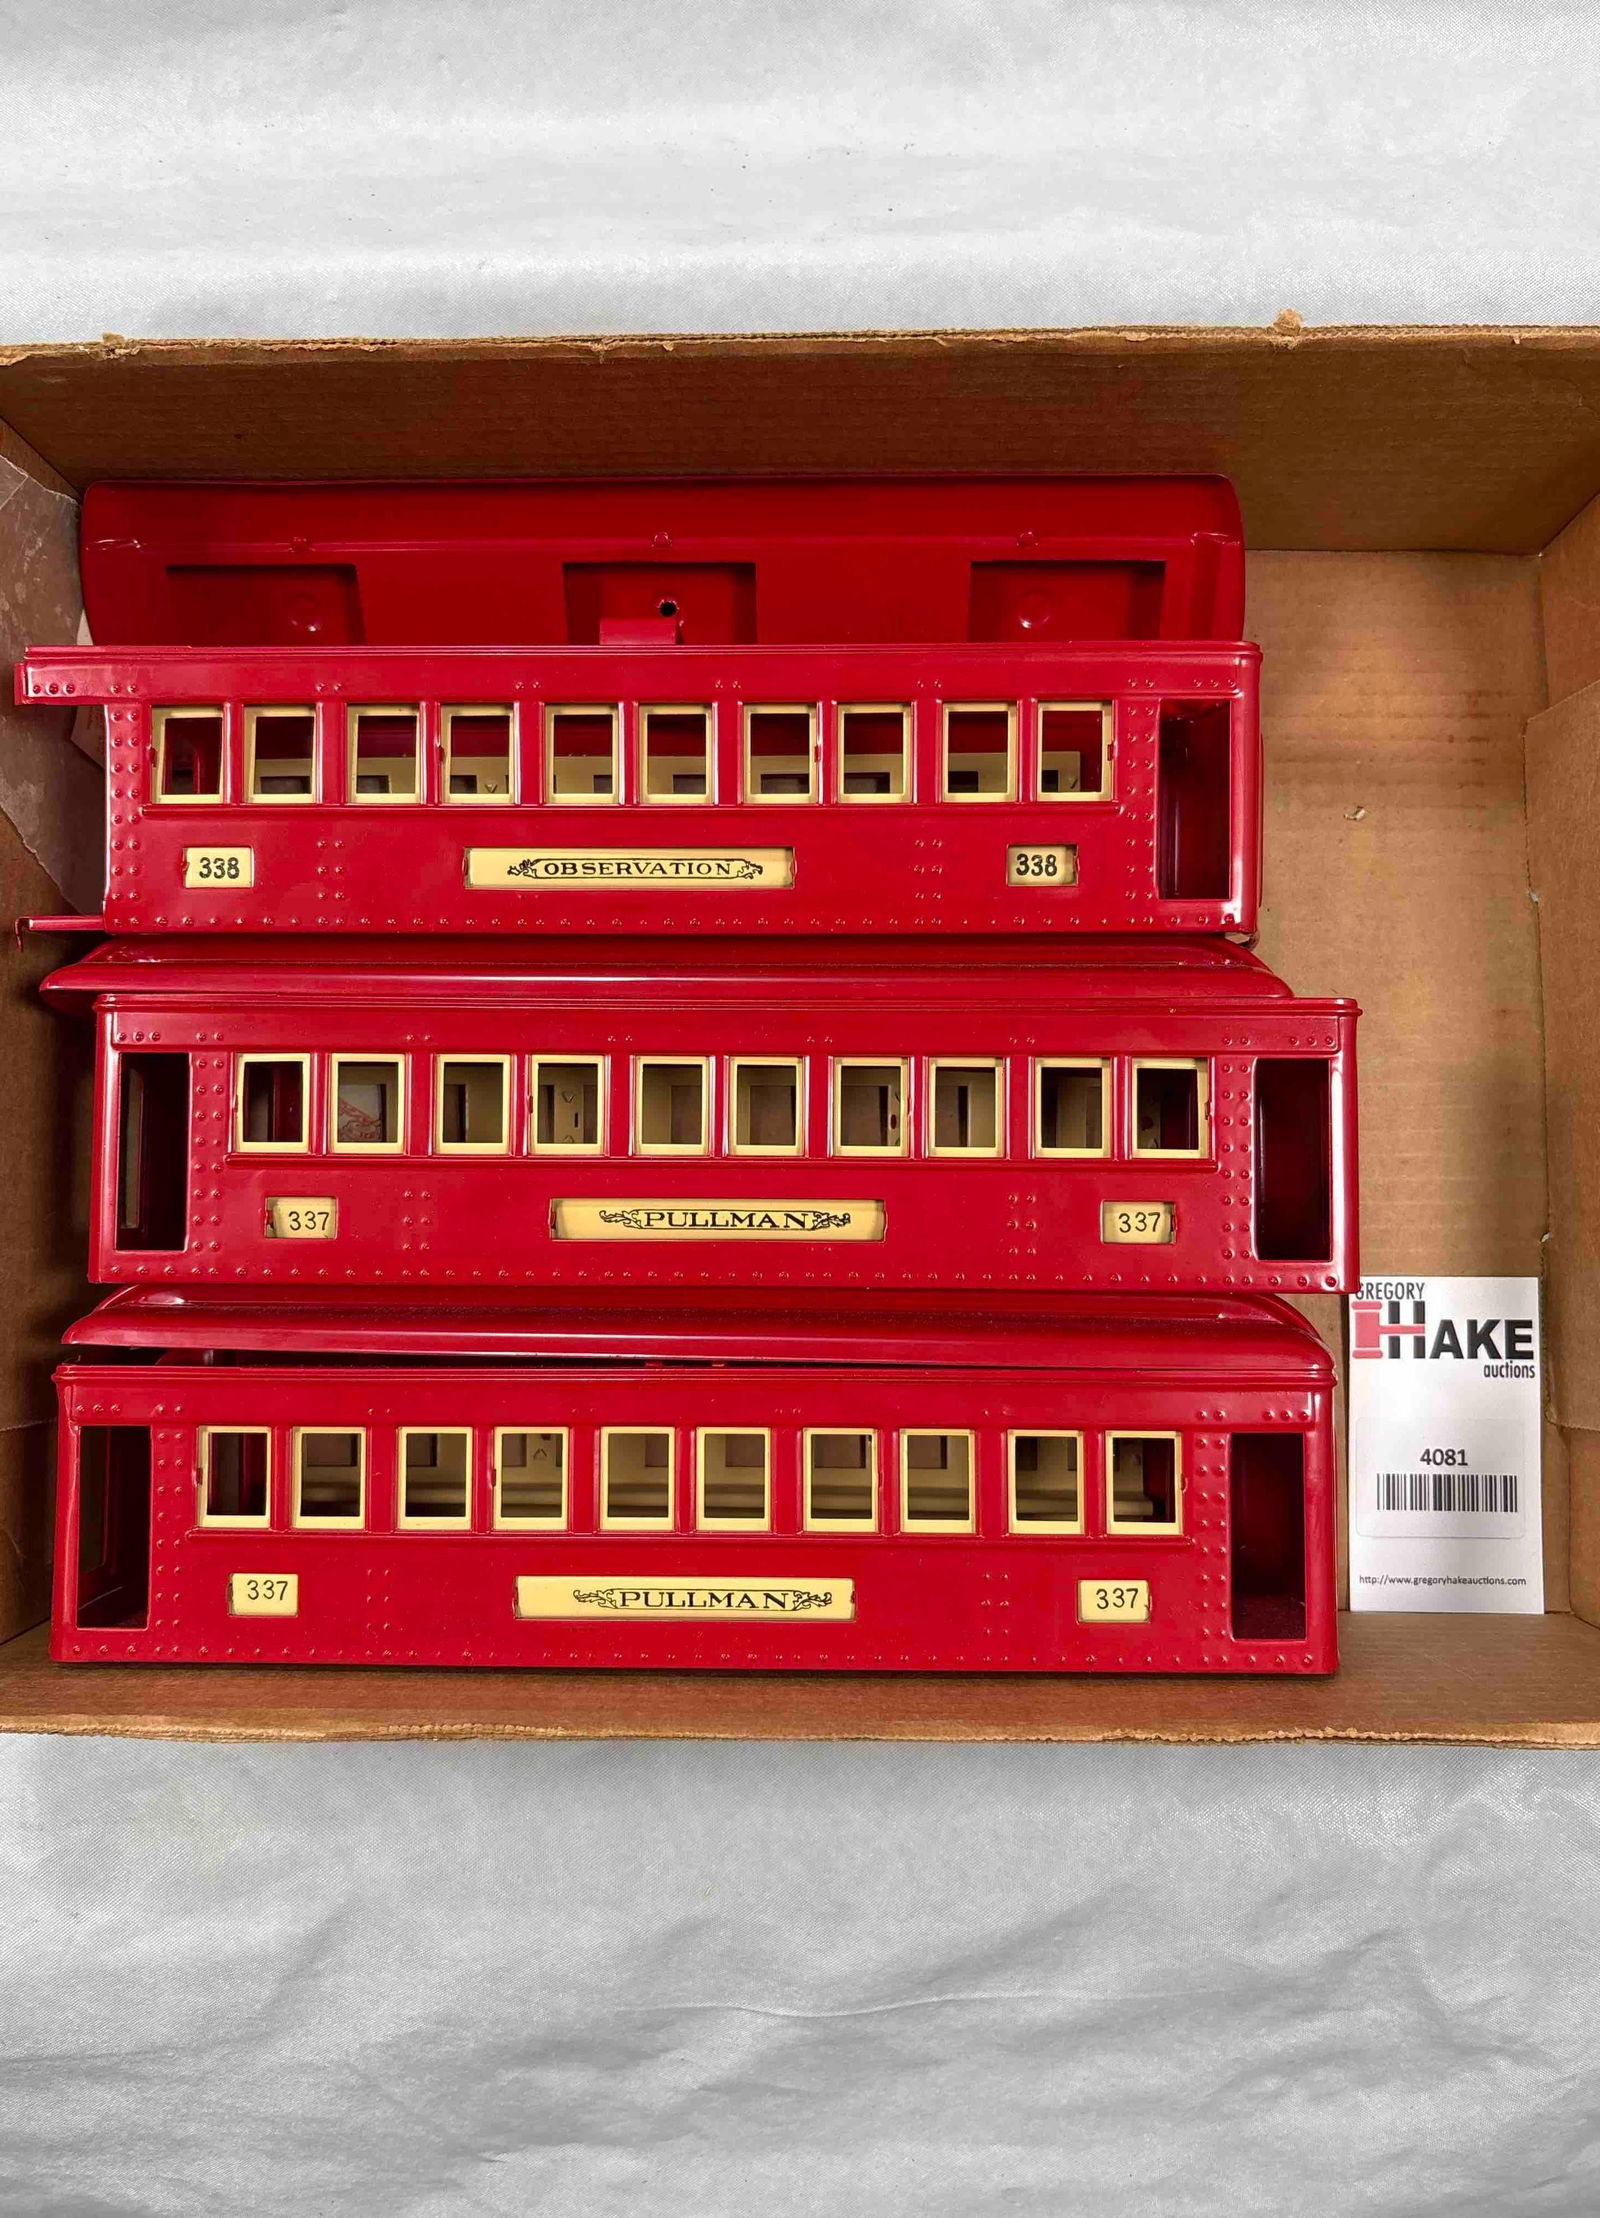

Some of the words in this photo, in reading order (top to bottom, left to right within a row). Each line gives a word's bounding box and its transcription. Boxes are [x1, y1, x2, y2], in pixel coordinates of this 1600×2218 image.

[199, 856, 240, 880] 338
[543, 861, 731, 876] OBSERVATION
[1015, 853, 1058, 877] 338
[288, 1210, 330, 1231] 337
[644, 1211, 808, 1229] PULLMAN
[1118, 1212, 1161, 1234] 337
[1355, 1282, 1425, 1300] GREGORY
[1384, 1300, 1535, 1360] HAKE
[1483, 1361, 1536, 1379] auctions
[1419, 1449, 1469, 1467] 4081
[246, 1579, 288, 1601] 337
[1359, 1575, 1527, 1586] http://www.gregoryhakeauctions.com
[619, 1590, 789, 1609] PULLMAN
[1096, 1587, 1139, 1610] 337
